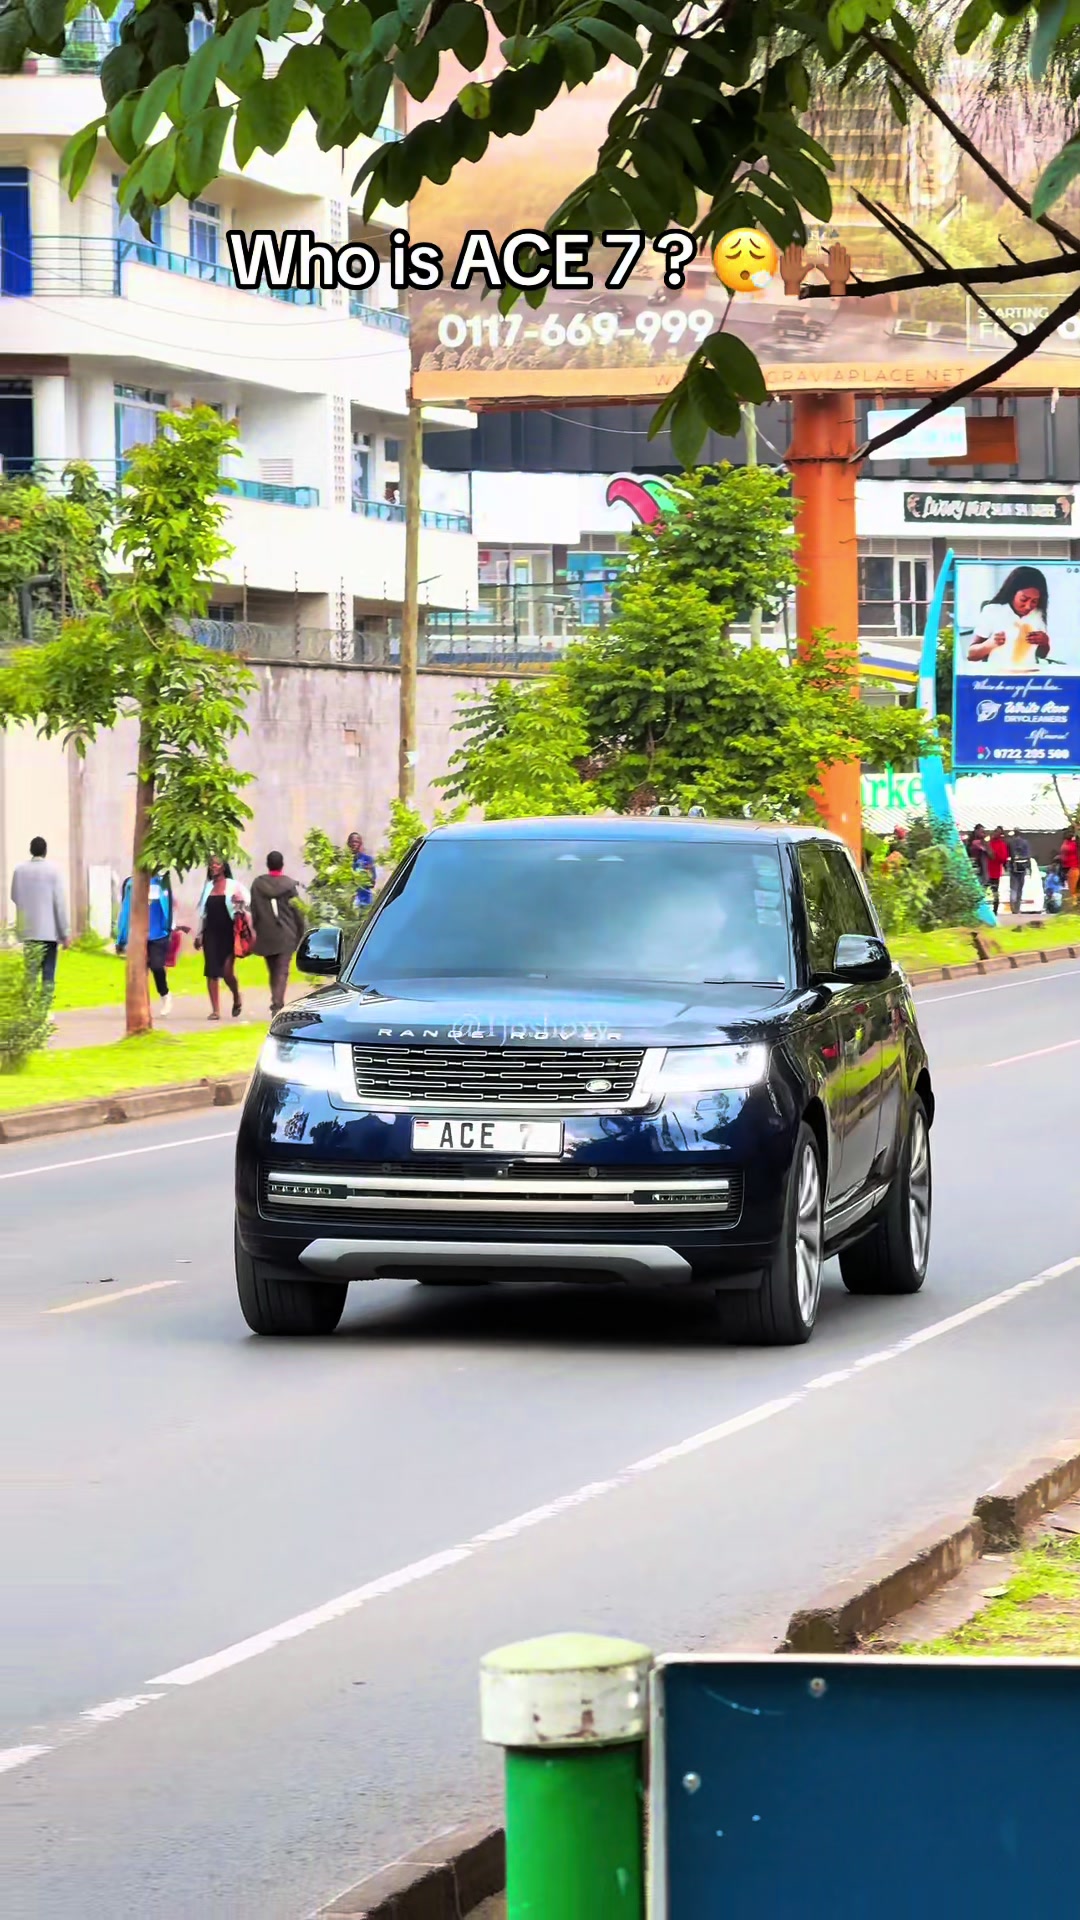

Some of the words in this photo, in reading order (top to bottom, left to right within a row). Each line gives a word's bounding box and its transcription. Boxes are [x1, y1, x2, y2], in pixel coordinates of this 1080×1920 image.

[437, 309, 714, 348] 0117-669-999
[377, 1027, 486, 1039] RANGE
[510, 1030, 622, 1042] ROVER
[439, 1121, 496, 1149] ACE
[519, 1122, 534, 1150] 7
